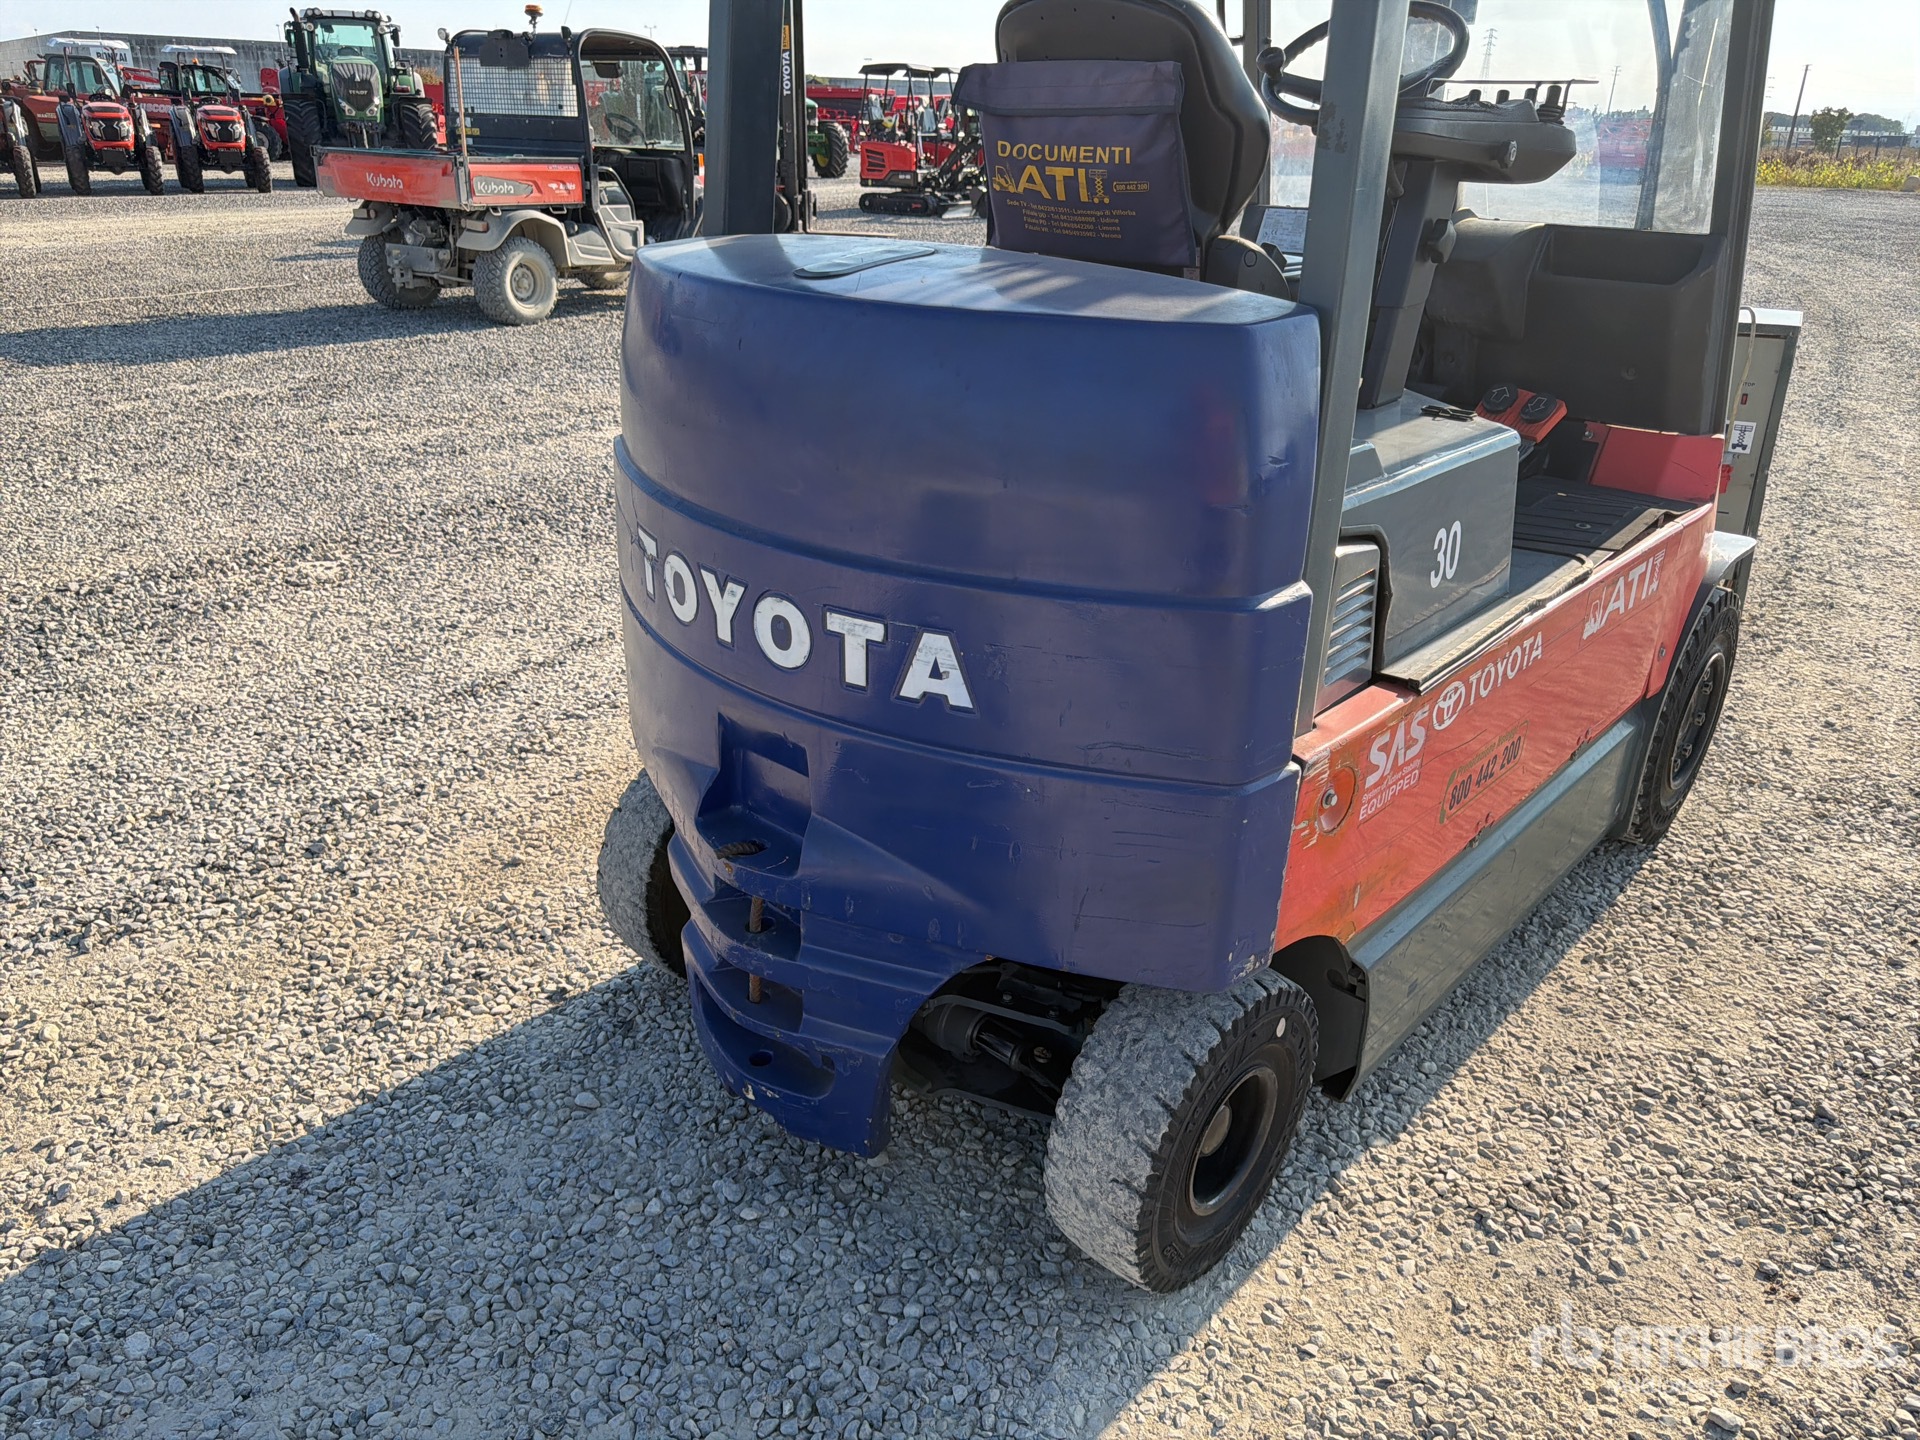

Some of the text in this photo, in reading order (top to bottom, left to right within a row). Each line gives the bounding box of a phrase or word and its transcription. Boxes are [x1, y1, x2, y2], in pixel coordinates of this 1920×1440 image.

[782, 51, 791, 96] TOYOTA
[366, 172, 404, 190] Kubota
[997, 140, 1131, 164] DOCUMENTI
[477, 181, 515, 194] Kubota
[1430, 520, 1462, 589] 30
[637, 523, 977, 713] TOYOTA
[1469, 631, 1543, 706] TOYOTA
[1365, 704, 1430, 790] SAS
[1449, 735, 1522, 811] 800 442 200
[1359, 769, 1420, 821] EQUIPPED
